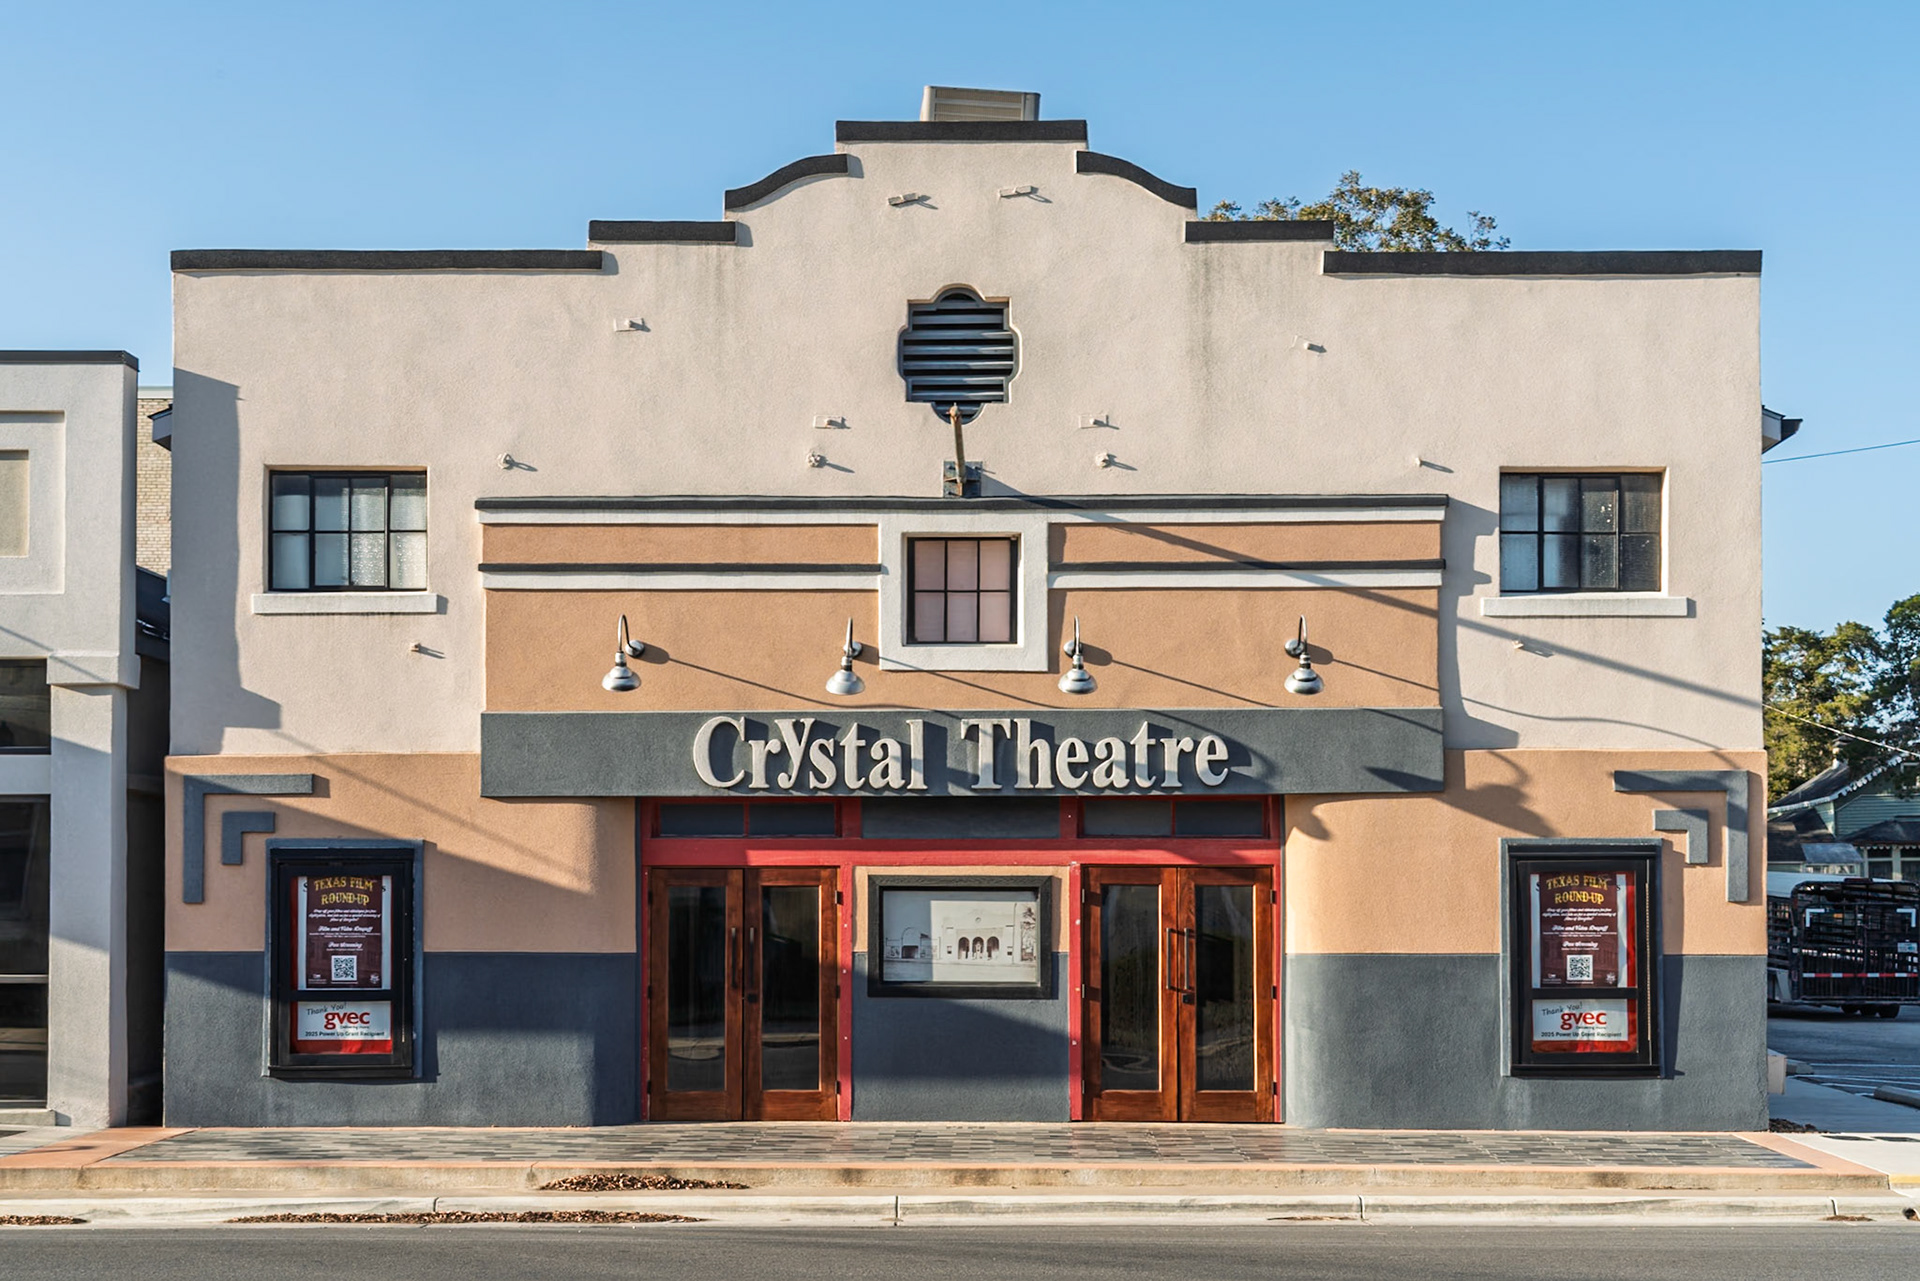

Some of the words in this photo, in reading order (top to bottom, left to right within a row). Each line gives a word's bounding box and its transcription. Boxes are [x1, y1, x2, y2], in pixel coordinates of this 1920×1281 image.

[692, 715, 928, 791] Crystal
[960, 718, 1229, 790] Theatre
[314, 877, 347, 891] TEXAS
[350, 877, 373, 892] FILM
[1545, 875, 1580, 890] TEXAS
[1583, 875, 1608, 891] FILM
[321, 892, 370, 906] ROUND-UP
[1554, 891, 1605, 905] ROUND-UP
[307, 1006, 328, 1015] Thank
[331, 1002, 347, 1010] You!
[1542, 1005, 1563, 1016] Thank
[1566, 1001, 1583, 1011] You!
[324, 1012, 370, 1030] gvec
[1560, 1012, 1607, 1031] gvec
